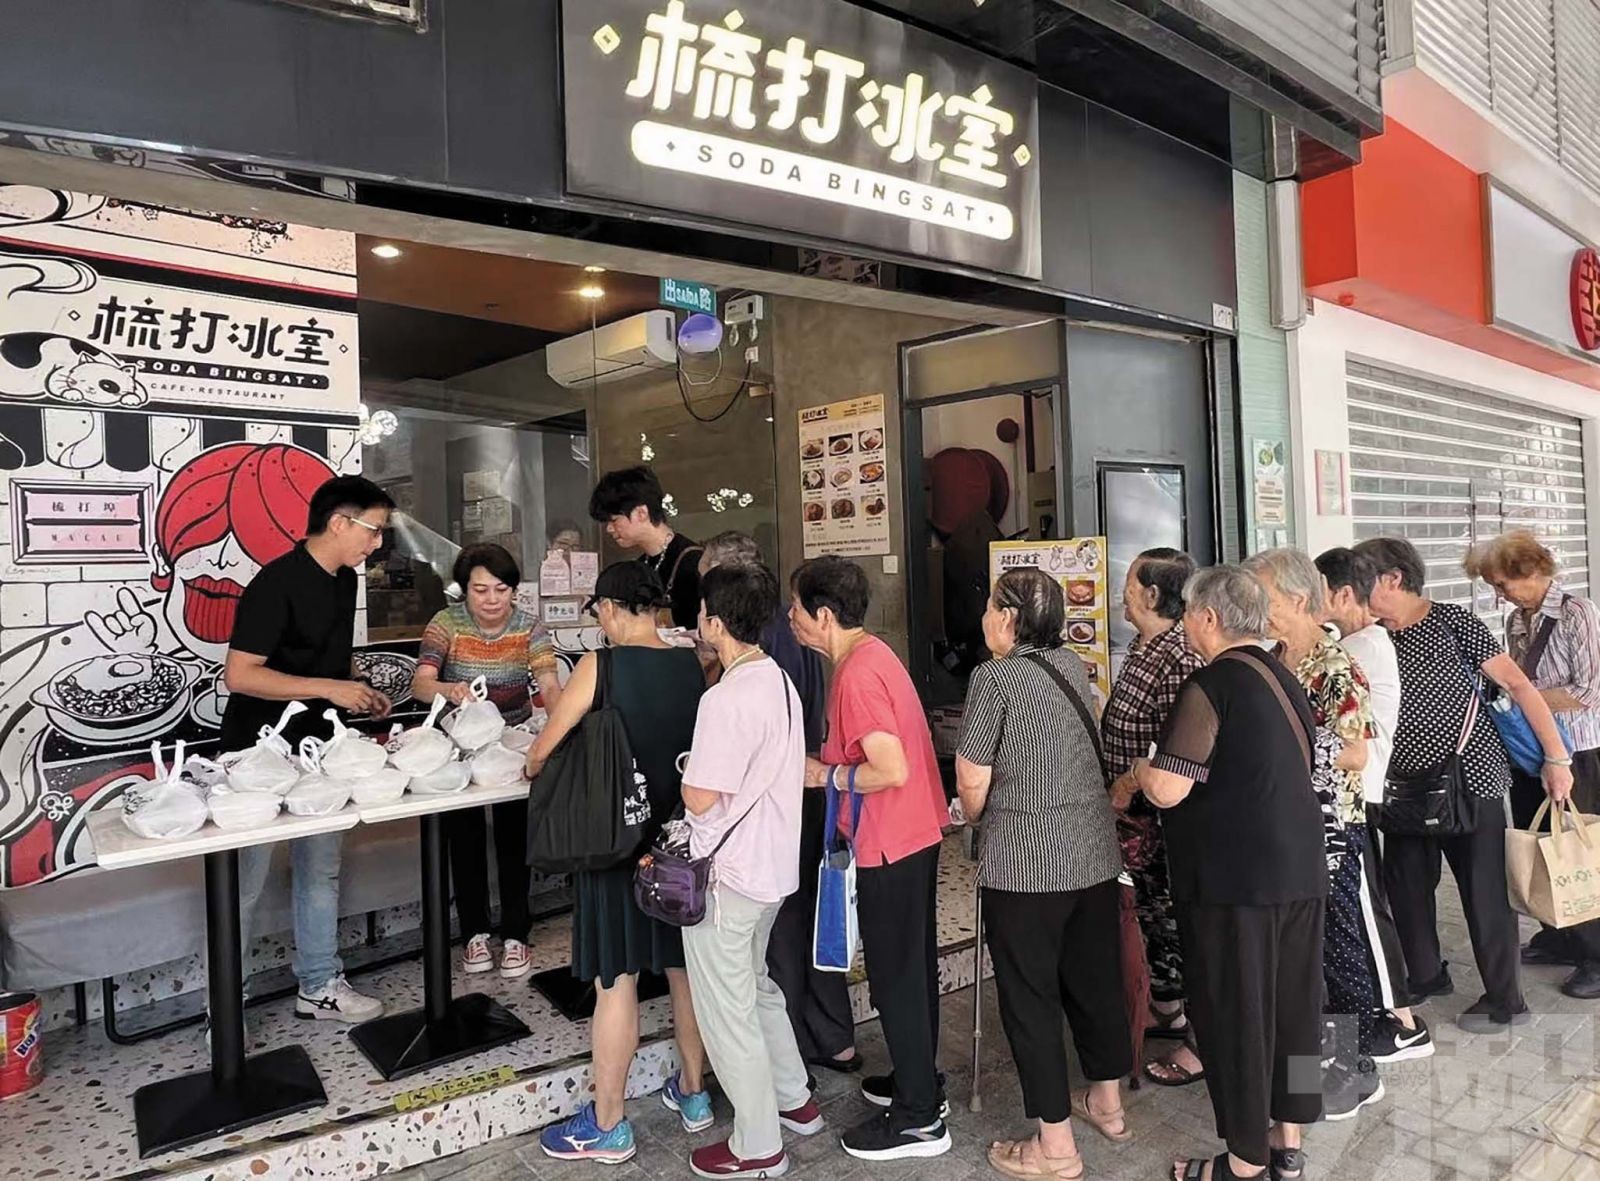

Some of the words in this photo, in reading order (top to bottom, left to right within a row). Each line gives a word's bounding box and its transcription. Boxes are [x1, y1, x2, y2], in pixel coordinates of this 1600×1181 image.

[626, 0, 1014, 188] 梳打冰室
[697, 144, 802, 183] SODA
[827, 173, 978, 222] BINGSAT
[87, 295, 335, 366] 梳打冰室
[137, 359, 197, 375] SODA
[209, 365, 306, 385] BINGSAT
[151, 382, 186, 393] CAFE
[198, 385, 286, 400] RESTAURANT
